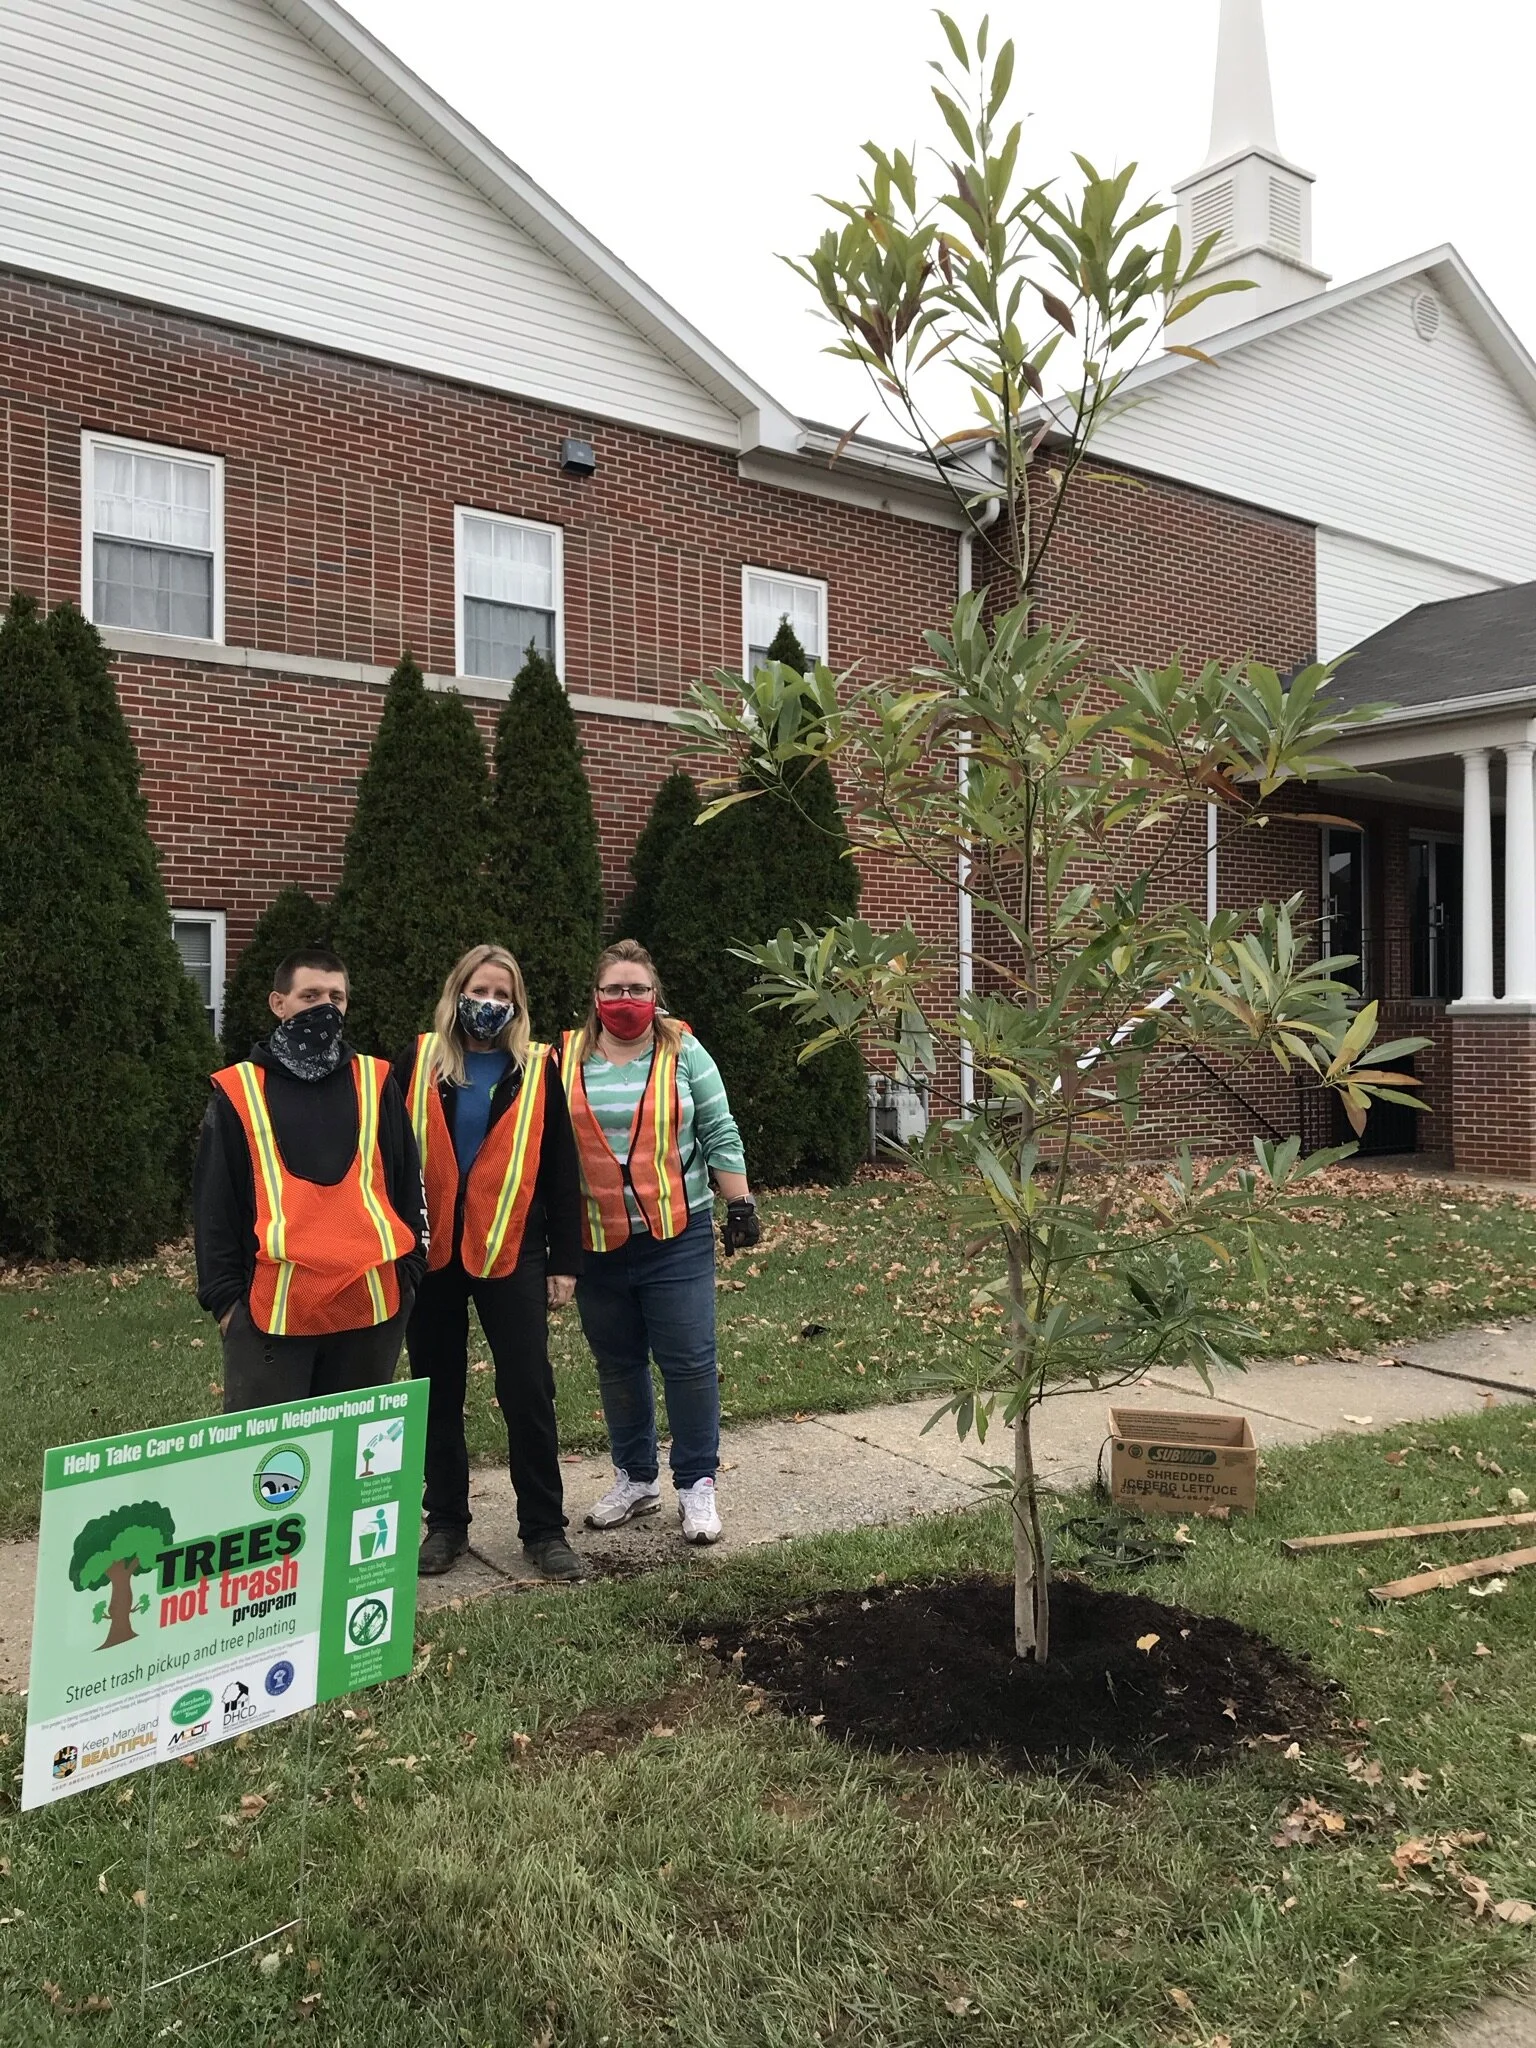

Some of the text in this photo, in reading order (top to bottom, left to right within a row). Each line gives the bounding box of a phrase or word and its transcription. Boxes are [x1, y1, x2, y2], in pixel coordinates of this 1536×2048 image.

[63, 1393, 409, 1476] Help Take Care of Your New Neighborhood Tree
[1152, 1447, 1211, 1463] SUBWAY
[1122, 1478, 1178, 1492] ICEBERG
[1182, 1483, 1238, 1496] LETTUCE
[1146, 1469, 1215, 1483] SHREDDED
[156, 1518, 301, 1588] TREES
[159, 1553, 298, 1628] not trash
[232, 1592, 296, 1627] program
[65, 1677, 107, 1704] Street
[110, 1664, 144, 1689] trash
[147, 1651, 190, 1681] pickup
[193, 1639, 218, 1661] and
[220, 1632, 244, 1652] tree
[247, 1618, 297, 1648] planting
[172, 1698, 211, 1717] Environmental
[180, 1694, 205, 1708] Maryland
[185, 1709, 199, 1718] Trust
[223, 1704, 257, 1726] DHCD
[82, 1715, 159, 1752] Keep Maryland
[81, 1731, 157, 1769] BEAUTIFUL
[68, 1774, 95, 1786] AMERICA
[96, 1763, 127, 1776] BEAUTIFUL
